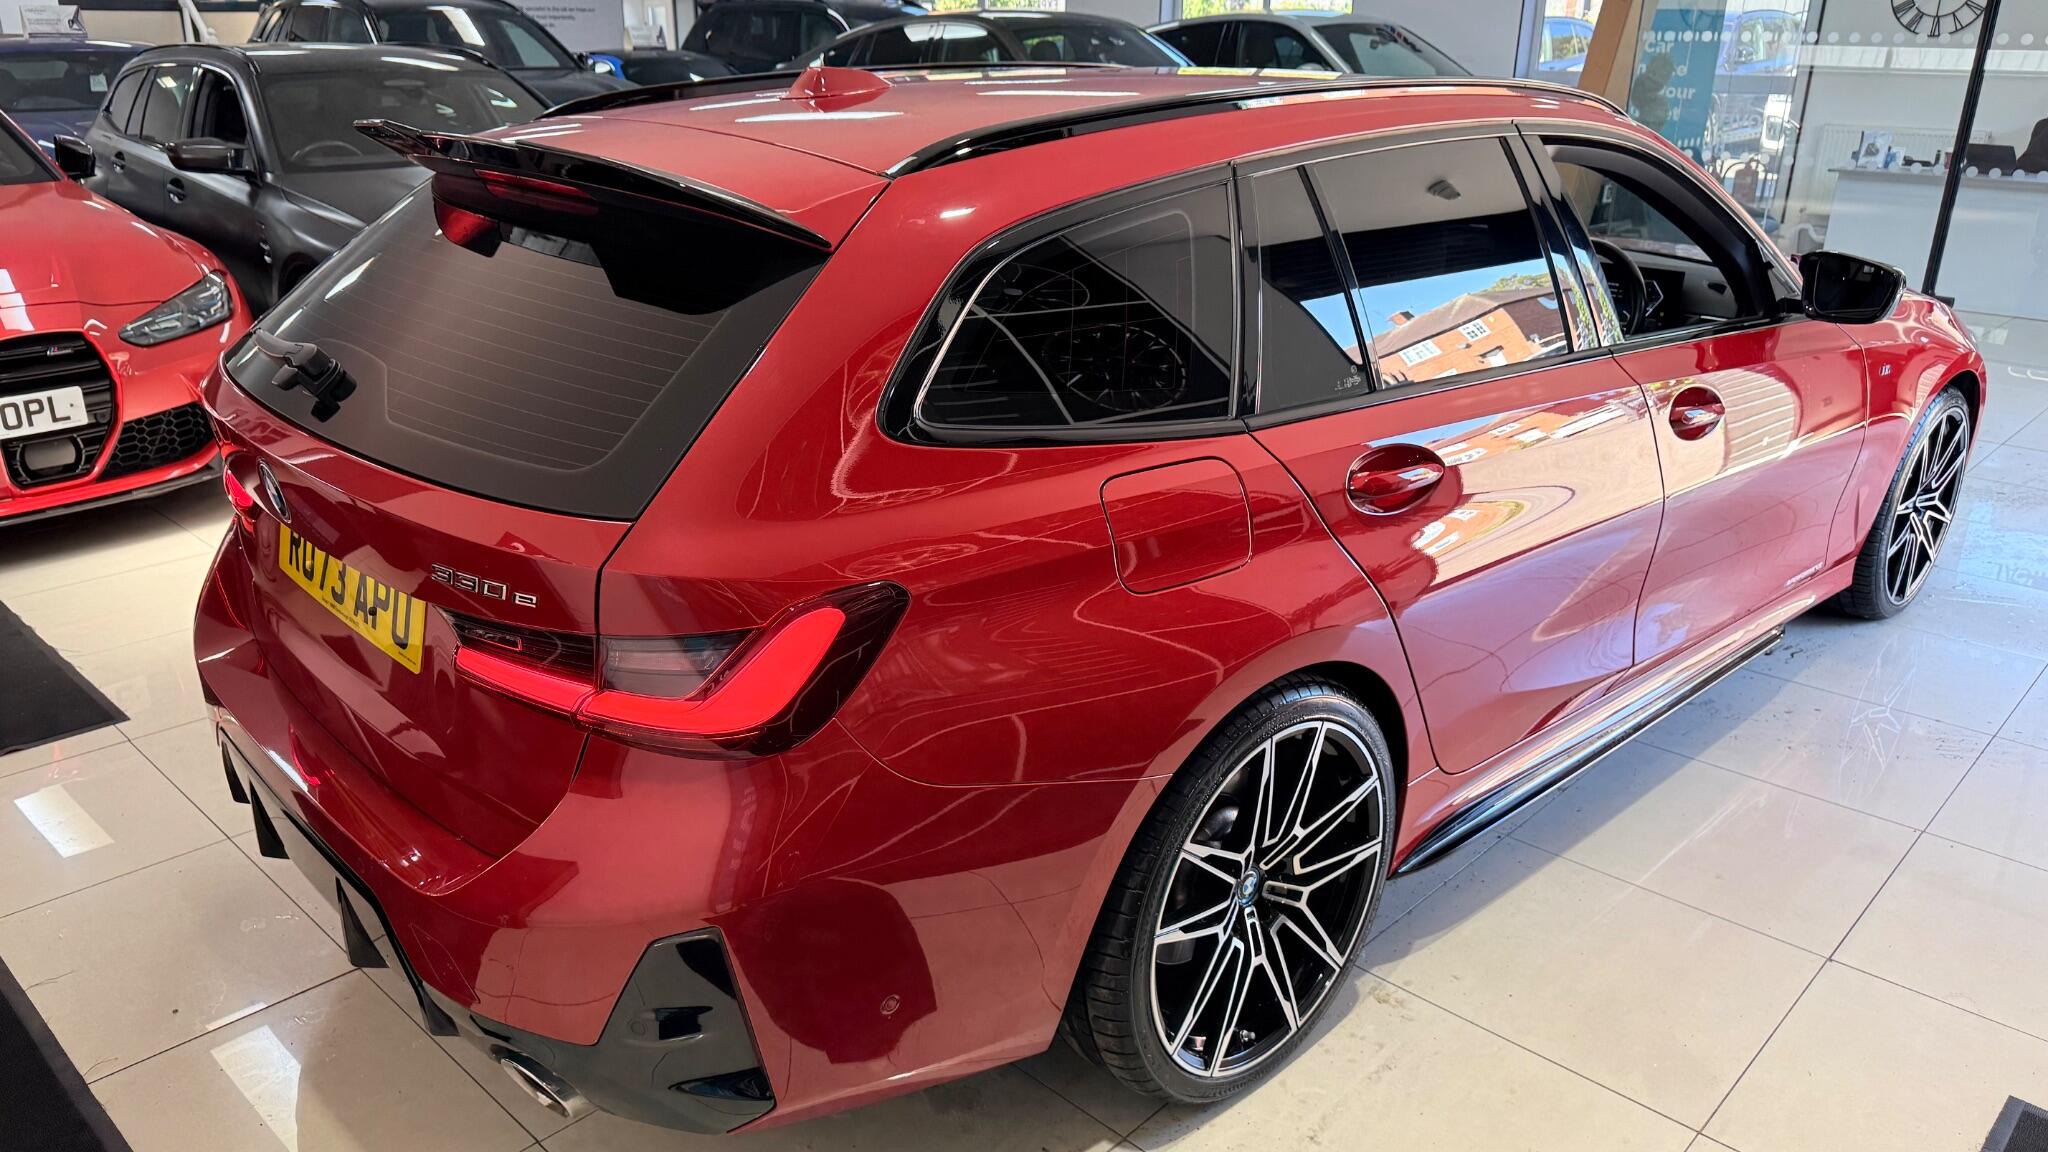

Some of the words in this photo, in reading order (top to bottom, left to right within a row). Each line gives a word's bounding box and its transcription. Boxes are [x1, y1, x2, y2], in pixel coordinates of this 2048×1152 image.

[1645, 41, 1675, 54] Car
[0, 396, 71, 430] OPL
[354, 574, 413, 650] APU
